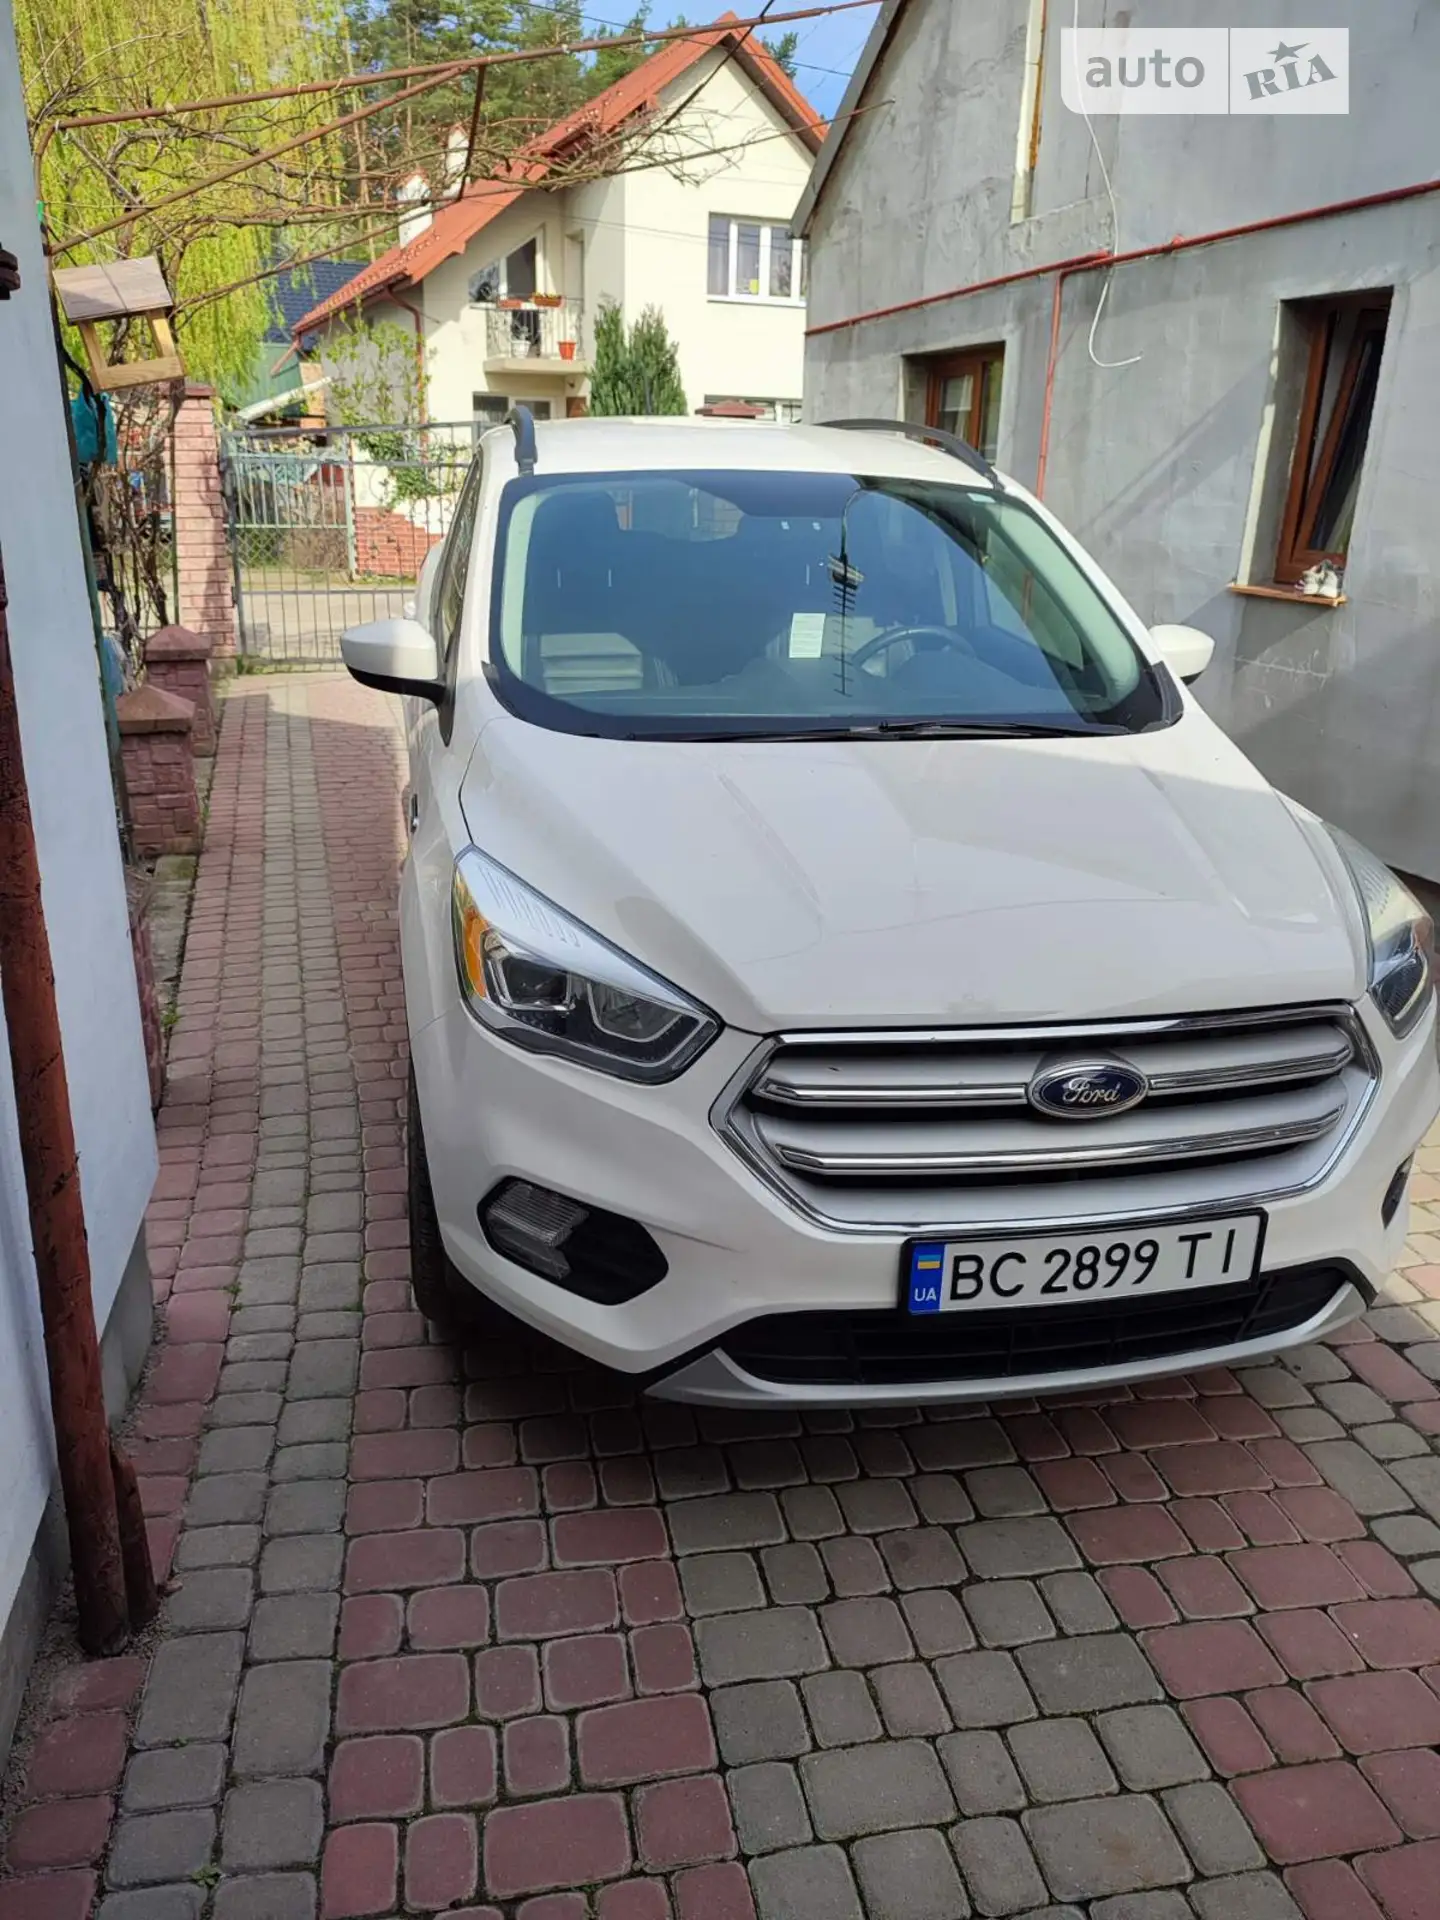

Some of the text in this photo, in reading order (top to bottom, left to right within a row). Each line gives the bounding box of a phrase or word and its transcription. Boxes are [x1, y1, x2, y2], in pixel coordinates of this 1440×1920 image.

[1061, 1077, 1122, 1103] Ford
[949, 1228, 1237, 1301] BC 2899 TI
[914, 1288, 937, 1302] UA
